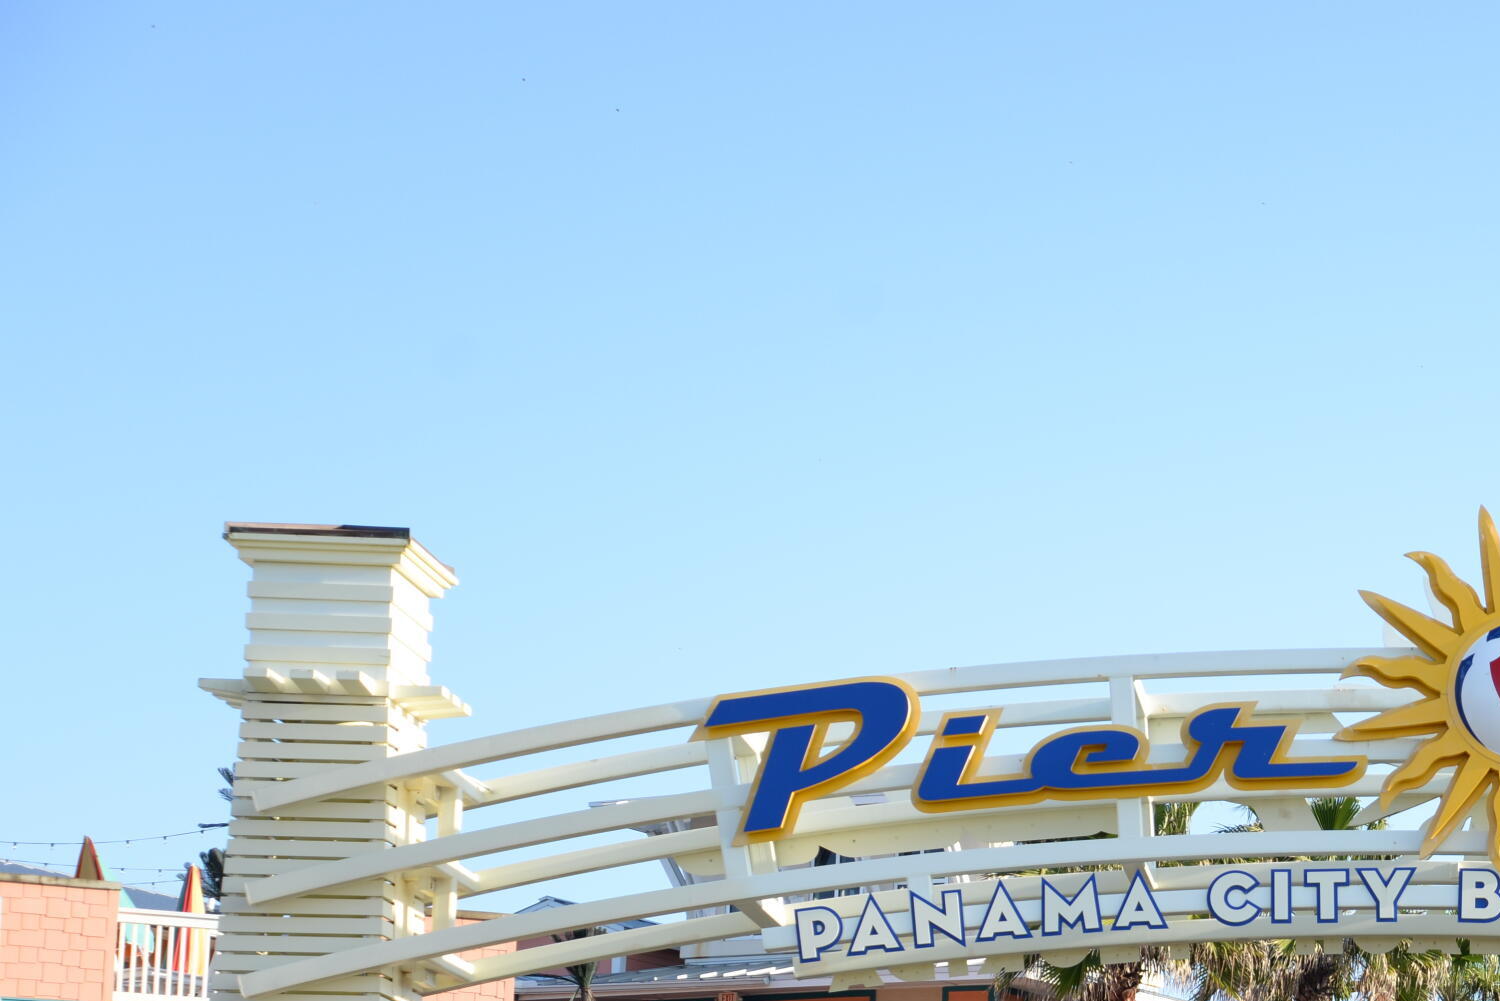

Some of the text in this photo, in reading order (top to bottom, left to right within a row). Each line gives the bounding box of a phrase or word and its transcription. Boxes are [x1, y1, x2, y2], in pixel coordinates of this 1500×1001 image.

[696, 676, 1368, 846] Pier
[795, 869, 1169, 963] PANAMA
[1206, 867, 1417, 927] CITY
